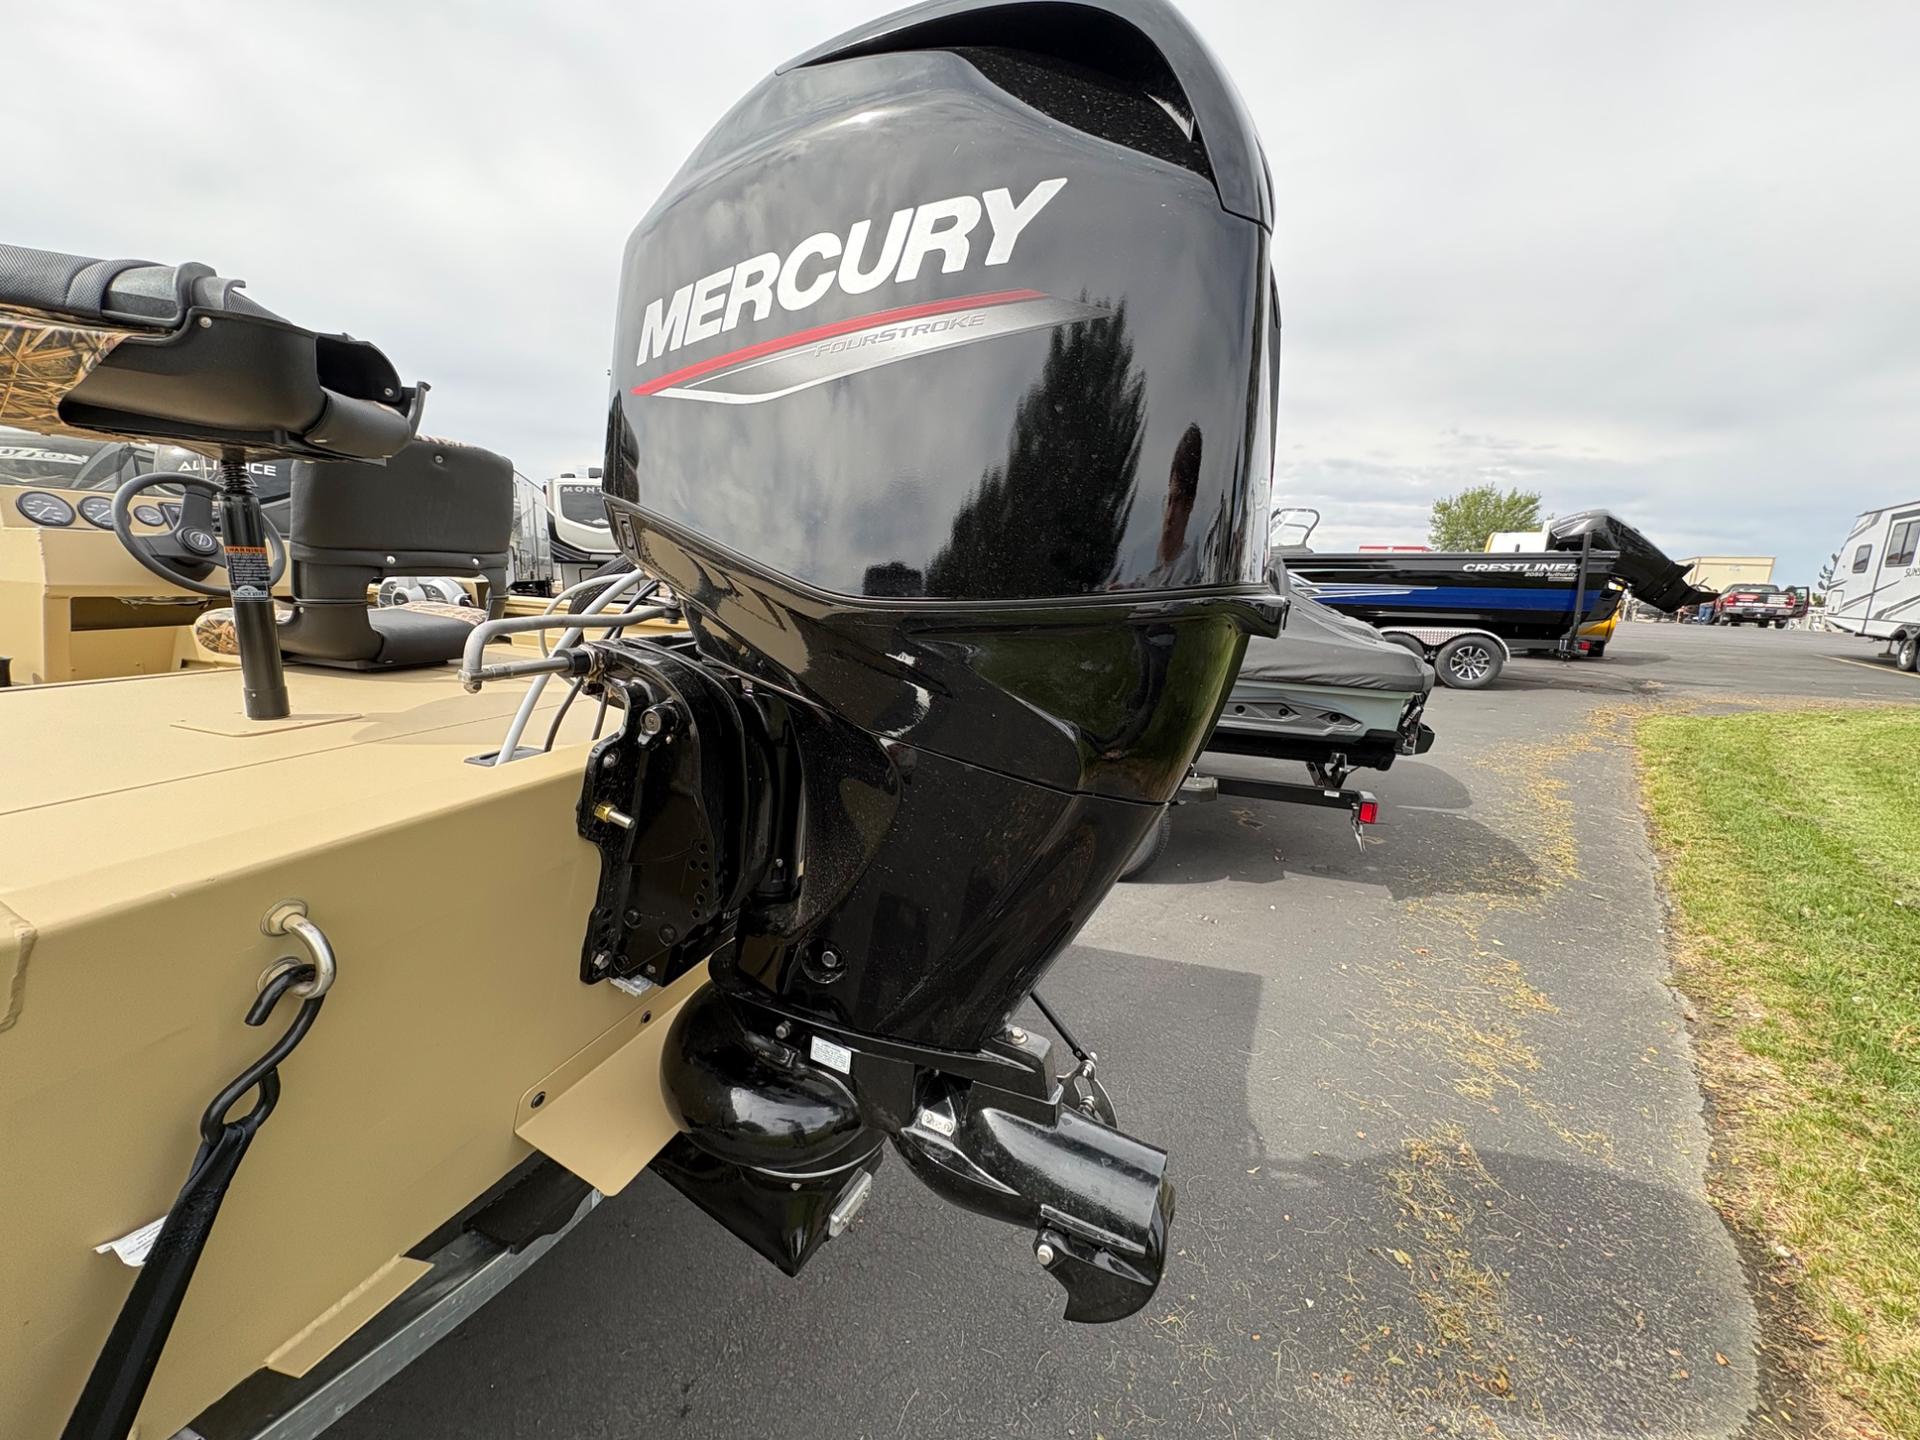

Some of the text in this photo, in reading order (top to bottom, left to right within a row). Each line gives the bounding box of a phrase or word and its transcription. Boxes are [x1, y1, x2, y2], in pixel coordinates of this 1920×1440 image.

[637, 177, 1068, 366] MERCURY
[813, 312, 988, 358] FOURSTROKE
[178, 460, 277, 477] ALLINCE
[1462, 563, 1579, 573] CRESTLINER
